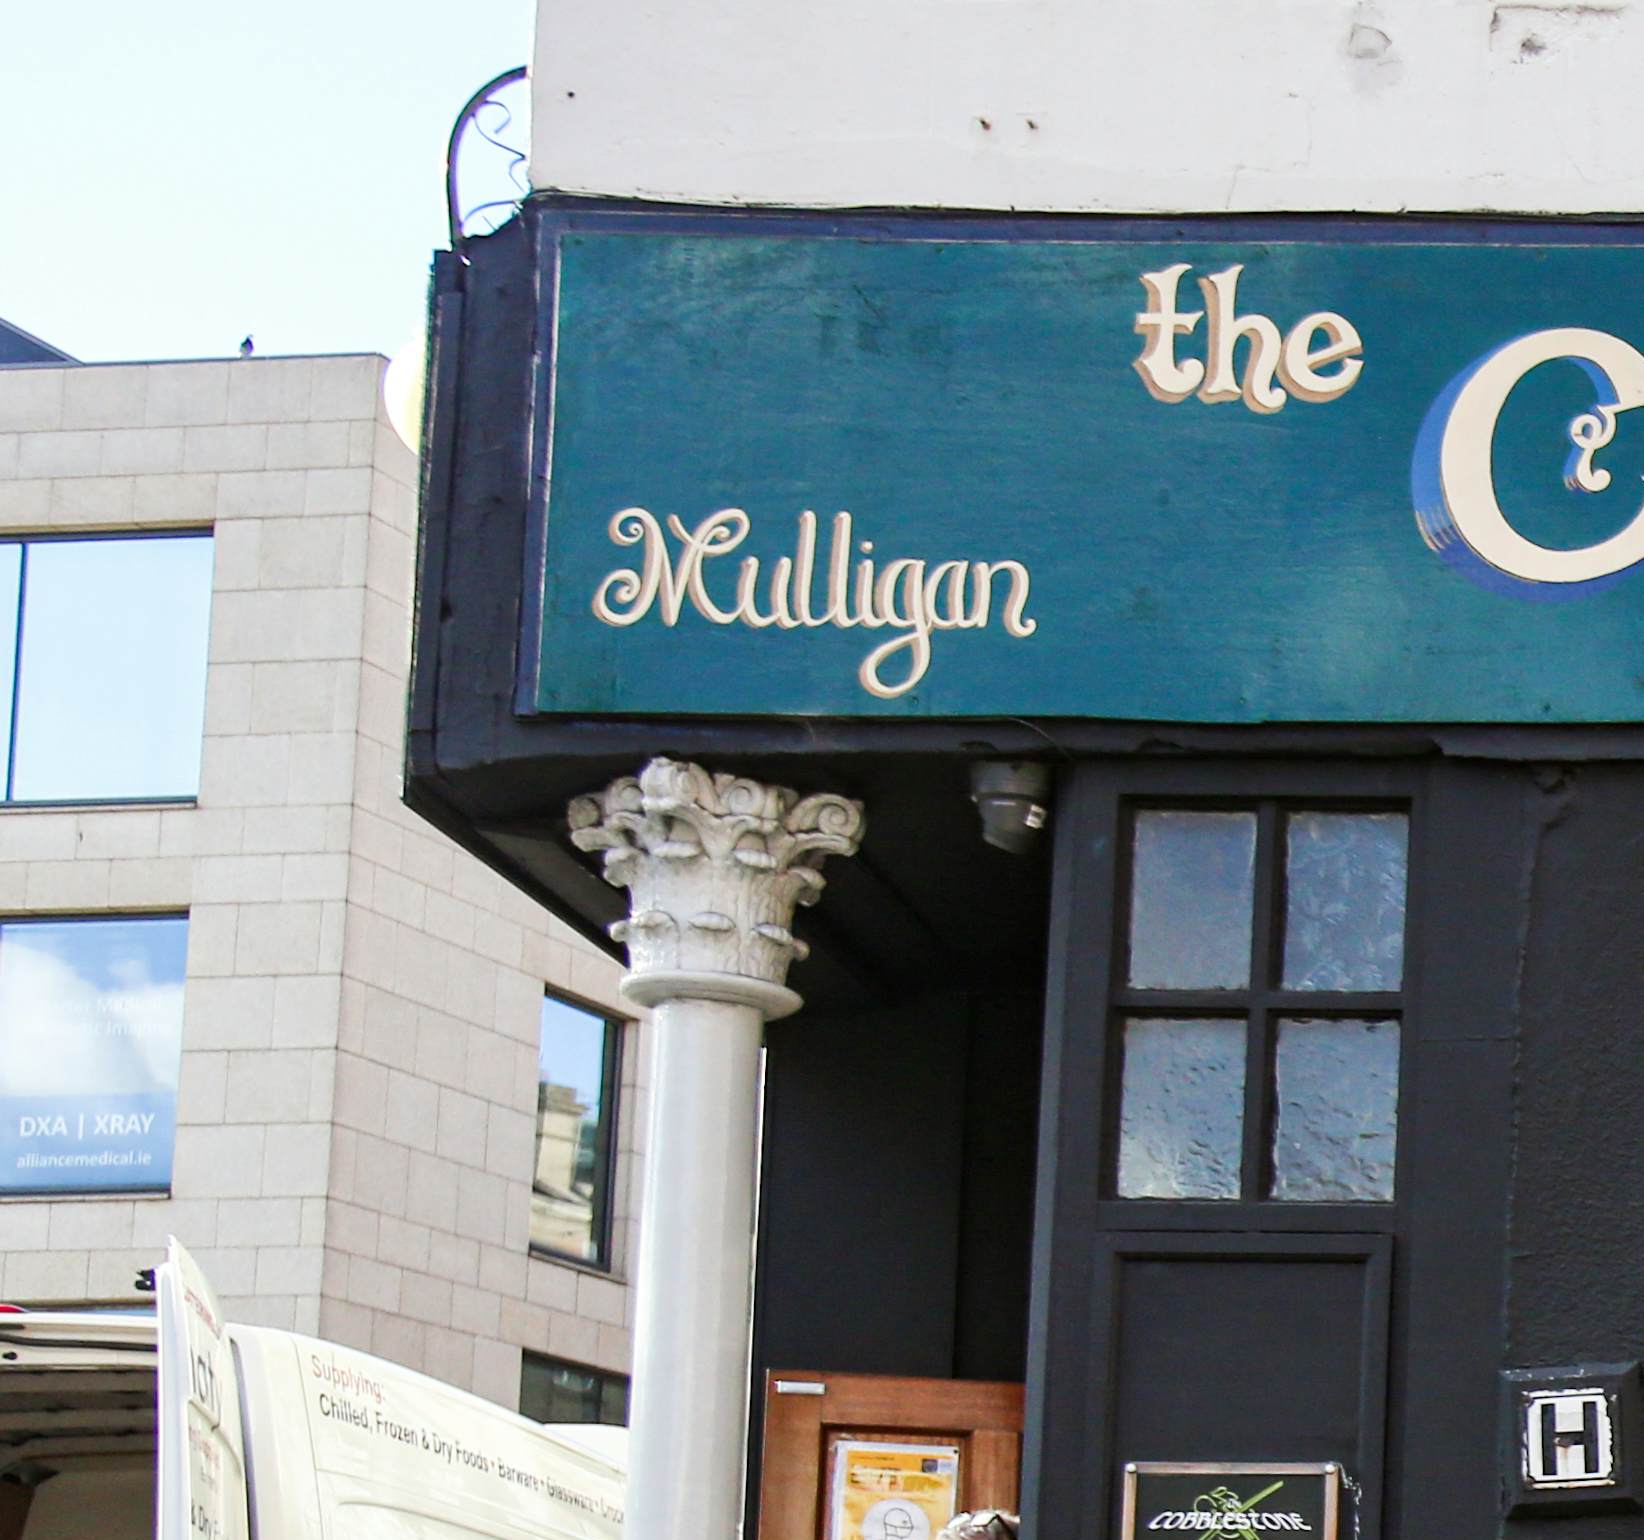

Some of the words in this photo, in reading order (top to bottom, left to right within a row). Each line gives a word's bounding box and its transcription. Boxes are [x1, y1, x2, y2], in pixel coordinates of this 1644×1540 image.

[1133, 264, 1363, 413] the
[592, 507, 1036, 699] Mulligan
[20, 1116, 67, 1137] DXA
[94, 1113, 155, 1135] XRAY
[17, 1150, 152, 1168] alliancemedical.ie
[311, 1354, 386, 1404] Supplying:
[320, 1393, 373, 1434] Chilled,
[375, 1412, 418, 1446] Frozen
[421, 1427, 430, 1449] &
[433, 1432, 452, 1464] Dry
[455, 1442, 489, 1472] Foods
[1541, 1401, 1599, 1475] H
[1148, 1511, 1312, 1531] COBBLESTONE
